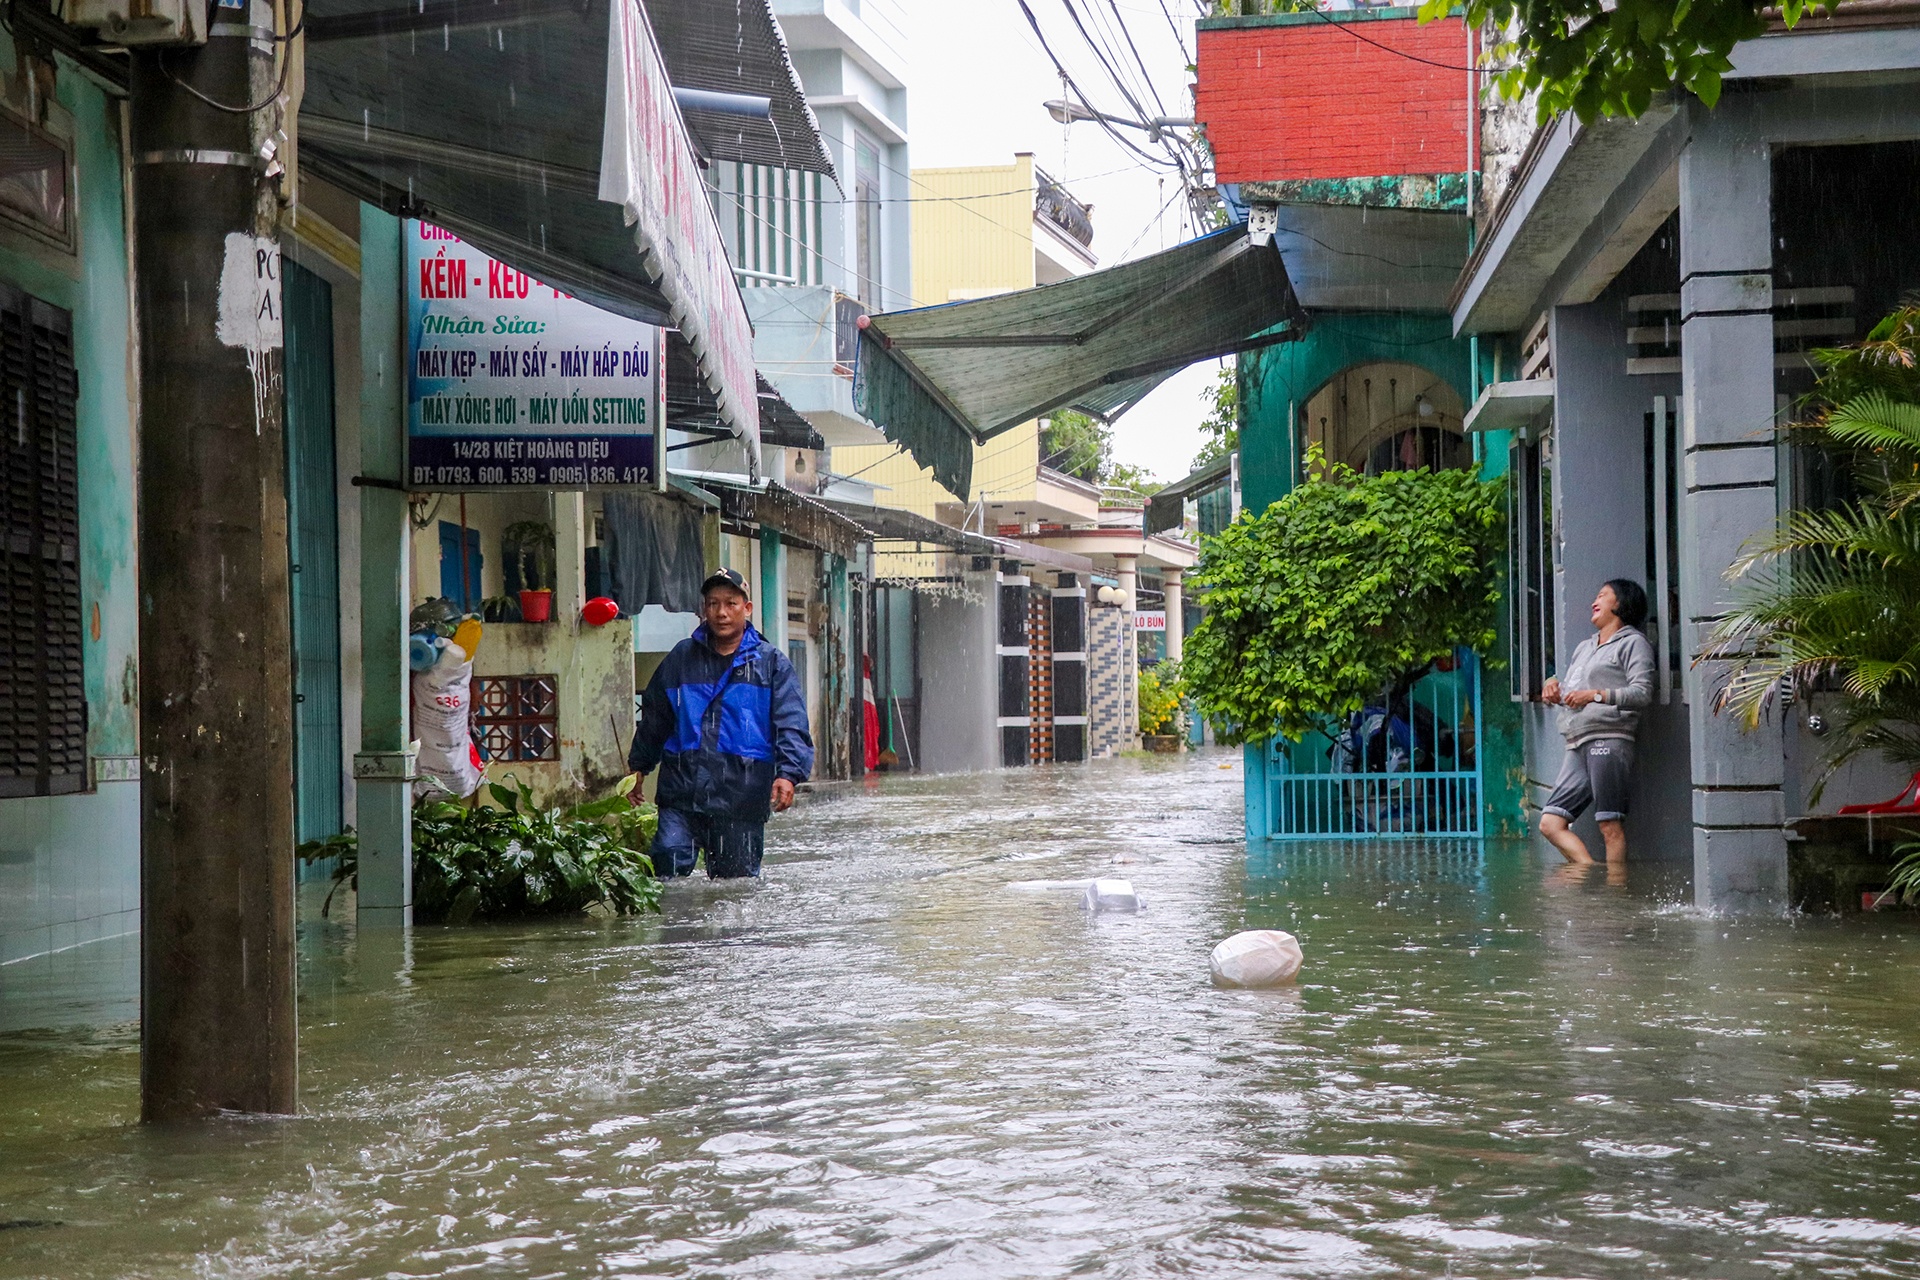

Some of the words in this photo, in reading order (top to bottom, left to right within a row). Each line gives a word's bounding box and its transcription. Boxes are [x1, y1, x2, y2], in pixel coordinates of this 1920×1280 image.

[420, 245, 467, 298] KỀM
[423, 315, 487, 337] Nhận
[492, 315, 546, 335] Sửa:
[419, 345, 447, 377] MÁY
[452, 350, 477, 383] KẸP
[490, 345, 518, 377] MÁY
[523, 341, 547, 377] SẤY
[561, 345, 589, 377] MÁY
[593, 341, 619, 377] HẤP
[623, 341, 649, 378] DẦU
[422, 391, 451, 425] MÁY
[455, 392, 491, 425] XÔNG
[494, 395, 517, 425] HƠI
[529, 392, 558, 425] MÁY
[562, 388, 589, 425] UỐN
[593, 397, 646, 425] SETTING
[453, 441, 490, 459] 14/28
[494, 438, 524, 462] KIỆT
[527, 438, 574, 459] HOÀNG
[578, 438, 609, 462] DIỆU
[413, 466, 434, 484] ĐT:
[437, 466, 475, 484] 0793.
[478, 466, 508, 484] 600.
[511, 466, 537, 484] 539
[590, 466, 620, 484] 836.
[623, 466, 649, 484] 412
[1590, 747, 1611, 756] GUCCI
